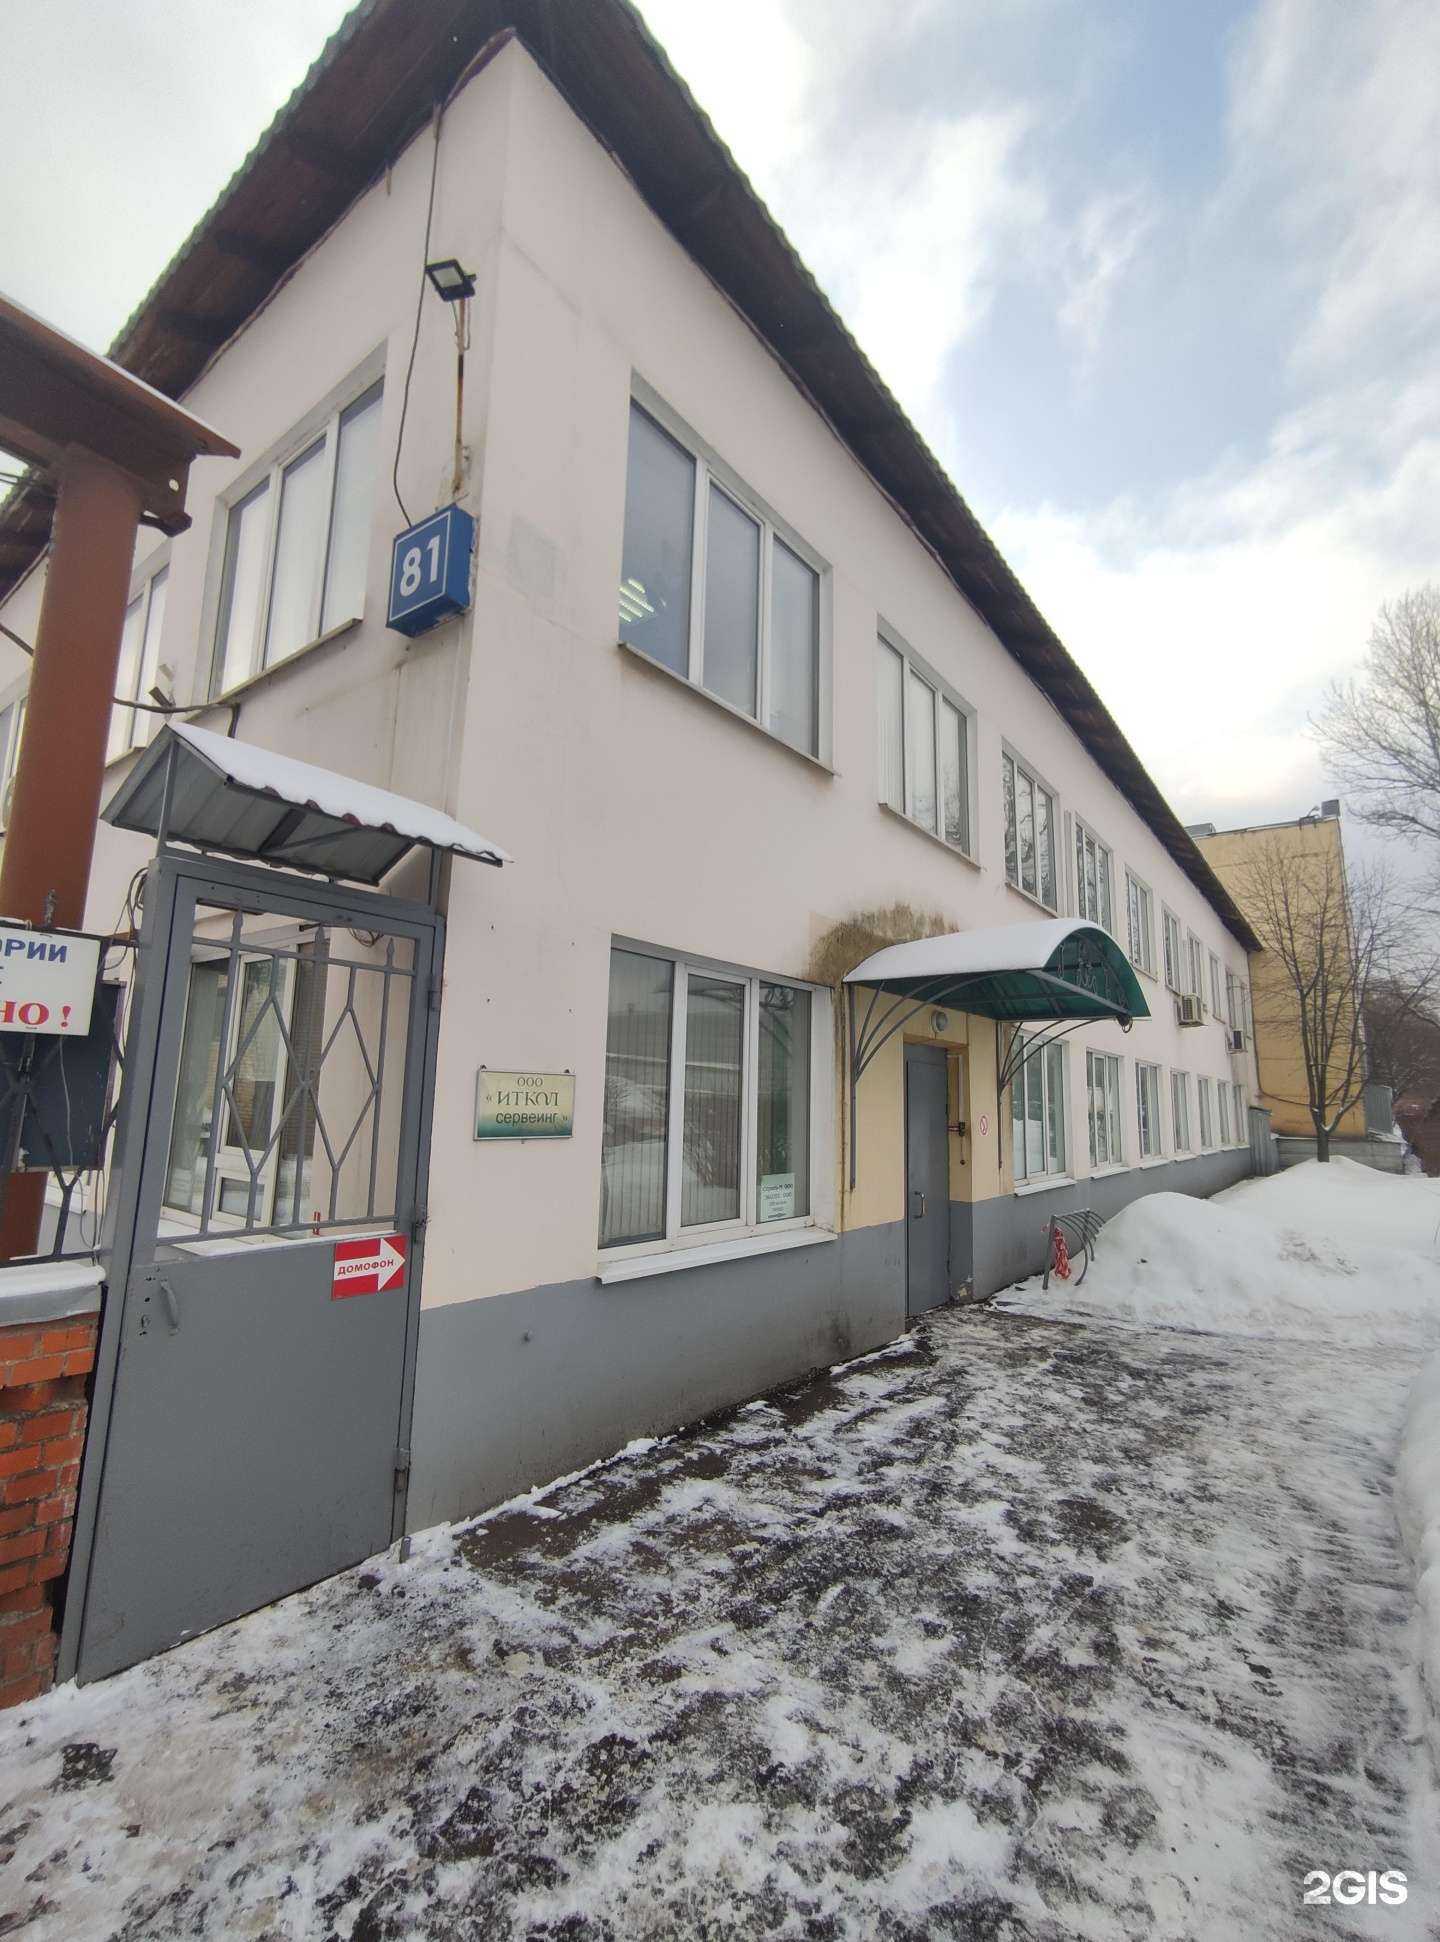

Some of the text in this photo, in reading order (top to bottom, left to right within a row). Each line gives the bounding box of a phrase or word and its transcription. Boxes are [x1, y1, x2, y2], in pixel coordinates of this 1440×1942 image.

[400, 534, 440, 597] 81
[0, 938, 68, 963] РИИ
[517, 1077, 543, 1087] ООО
[336, 1259, 394, 1276] ДОМОФОН
